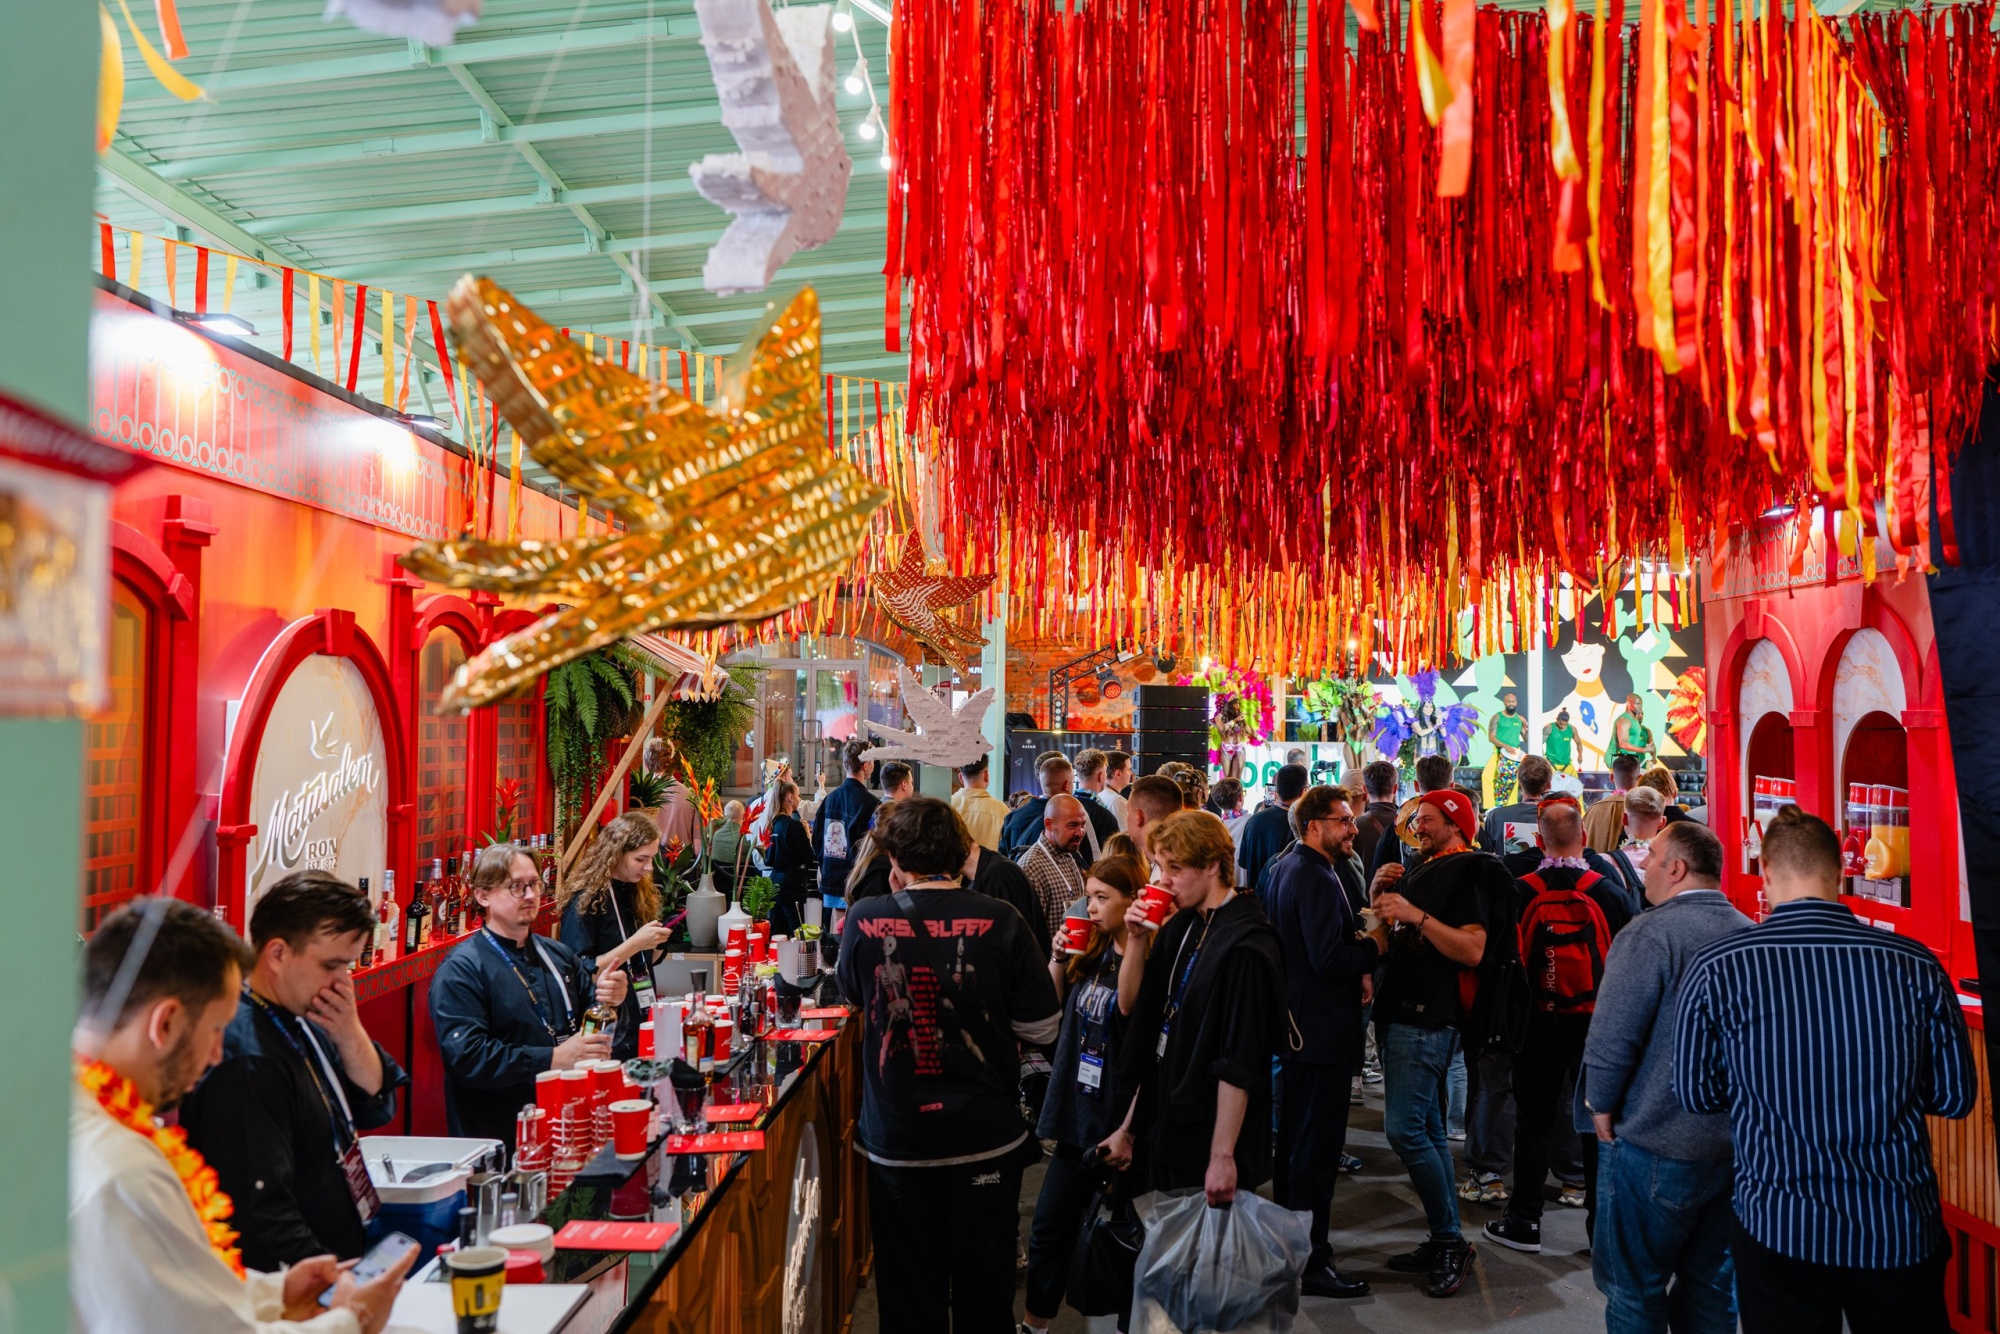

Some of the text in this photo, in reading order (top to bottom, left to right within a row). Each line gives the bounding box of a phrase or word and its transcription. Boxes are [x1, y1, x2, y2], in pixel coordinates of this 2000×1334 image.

[248, 743, 380, 890] Matusalem
[306, 838, 338, 860] RON
[857, 917, 994, 939] NOSBLEED
